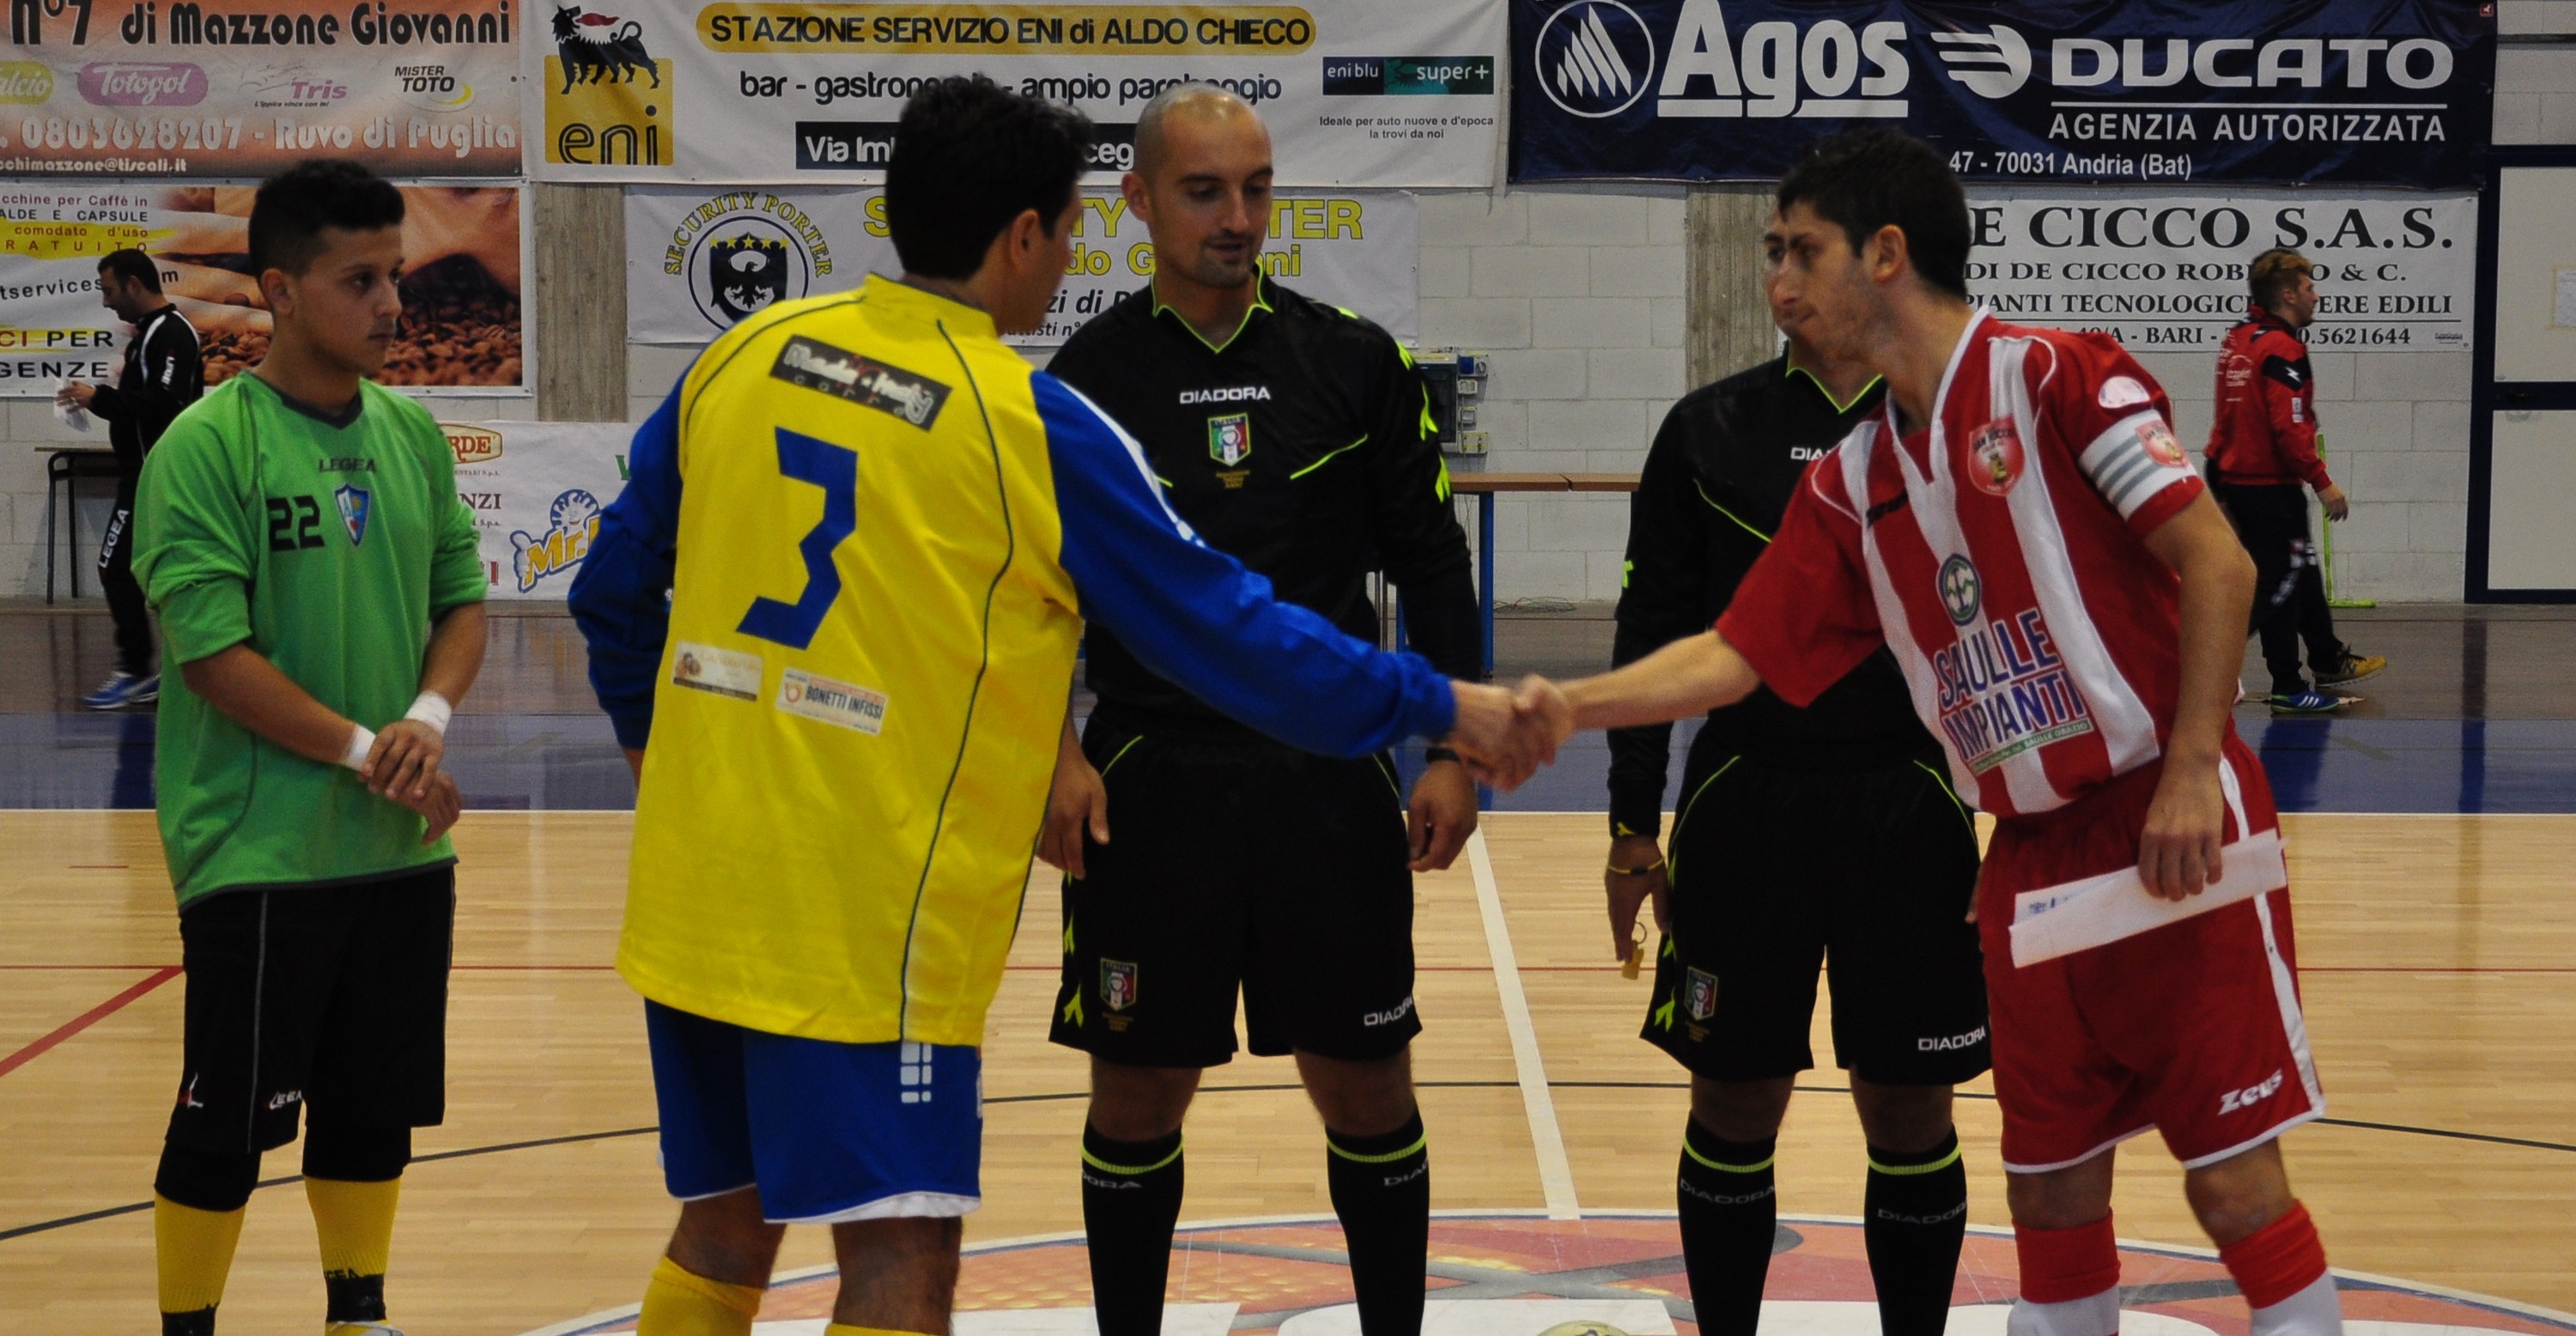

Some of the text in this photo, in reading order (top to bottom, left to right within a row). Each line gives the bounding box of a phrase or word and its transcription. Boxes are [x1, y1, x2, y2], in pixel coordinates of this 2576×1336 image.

[120, 0, 156, 44] di
[170, 3, 340, 46] Mazzone
[350, 0, 510, 46] Giovanni
[711, 15, 1310, 45] STAZIONE SERVIZIO ENI di ALDO CHIECO
[394, 65, 445, 77] MISTER
[1658, 0, 1910, 117] Agos
[2050, 38, 2454, 88] DUCATO
[402, 76, 455, 94] TOTO
[739, 70, 787, 98] bar
[1021, 72, 1111, 105] ampio
[1417, 64, 1490, 84] super+
[291, 80, 347, 100] Tris
[558, 105, 659, 165] eni
[1320, 116, 1352, 126] Ideale
[1355, 117, 1374, 128] per
[1376, 117, 1400, 126] auto
[1404, 118, 1438, 126] nuove
[1450, 116, 1494, 128] d'epoca
[1382, 130, 1407, 139] trovi
[1410, 130, 1424, 139] da
[1427, 130, 1444, 139] noi
[2049, 112, 2445, 142] AGENZIA AUTORIZZATA
[21, 117, 242, 150] 0803628207
[273, 117, 353, 150] Ruvo
[364, 117, 396, 149] di
[407, 117, 517, 157] Puglia
[805, 136, 849, 163] Via
[1949, 151, 1973, 173] 47
[1995, 152, 2056, 173] 70031
[2063, 153, 2135, 176] Andria
[2141, 153, 2192, 180] (Bat)
[58, 197, 82, 207] per
[88, 194, 128, 206] Caffè
[135, 195, 148, 206] in
[52, 210, 62, 221] E
[77, 210, 148, 222] CAPSULE
[2028, 207, 2251, 248] CICCO
[2275, 208, 2453, 249] S.A.S.
[15, 225, 148, 238] comodato d'uso
[664, 191, 758, 276] SECURITY
[764, 193, 833, 277] PORTER
[1965, 263, 2000, 280] DI
[2009, 263, 2053, 280] DE
[2062, 263, 2166, 281] CICCO
[2341, 264, 2368, 282] &
[2377, 264, 2407, 282] C.
[2379, 295, 2451, 314] EDILI
[46, 331, 114, 348] PER
[2147, 327, 2202, 343] BARI
[1179, 386, 1271, 404] DIADORA
[319, 458, 376, 473] LEGEA
[266, 495, 325, 552] 22
[736, 426, 859, 650] 3
[98, 509, 130, 569] LEGEA
[1935, 608, 2062, 712] SAULLE
[805, 684, 848, 709] BONETTI
[848, 697, 884, 720] INFISSI
[1941, 669, 2087, 761] IMPIANTI
[1917, 1026, 1986, 1052] DIADORA
[2217, 1069, 2284, 1116] Zeus
